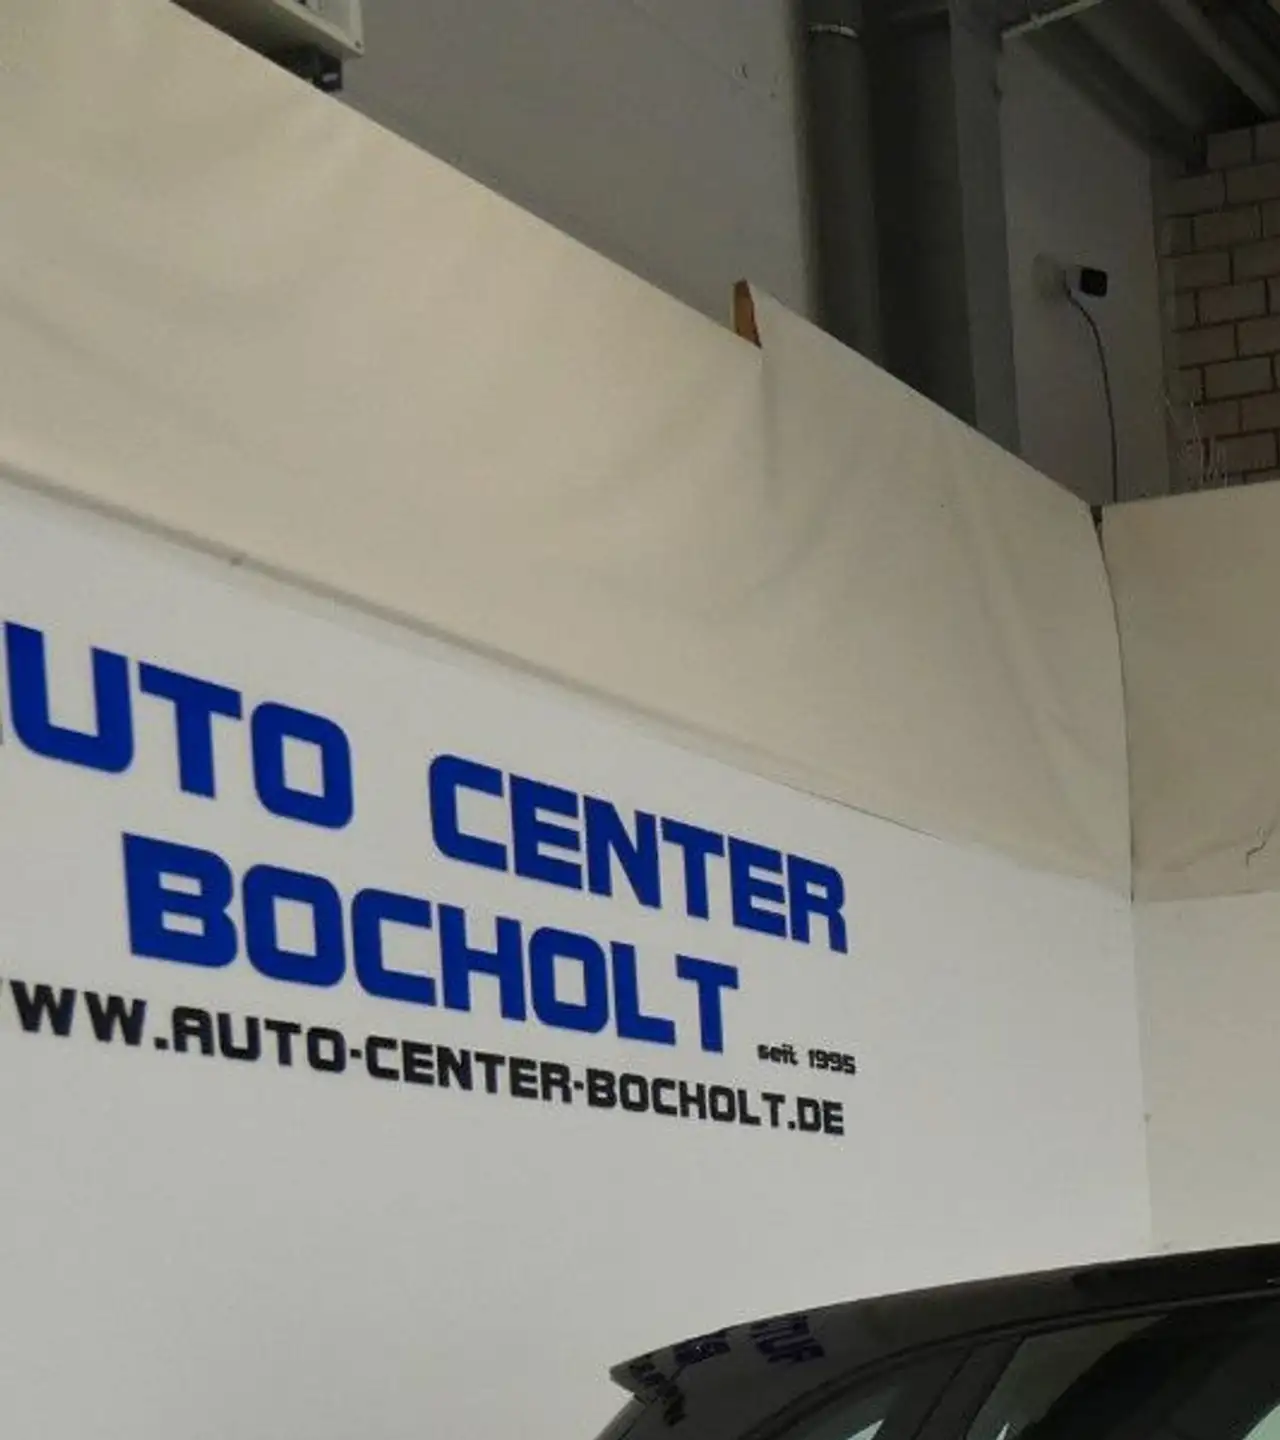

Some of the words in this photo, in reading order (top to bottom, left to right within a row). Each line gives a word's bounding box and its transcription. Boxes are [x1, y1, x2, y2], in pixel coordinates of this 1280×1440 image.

[0, 622, 355, 829] UTO
[428, 755, 848, 954] CENTER
[122, 832, 739, 1053] BOCHOLT
[0, 977, 845, 1137] WW.AUTO-CENTER-BOCHOLT.DE
[757, 1043, 798, 1066] seit
[808, 1049, 856, 1076] 1995
